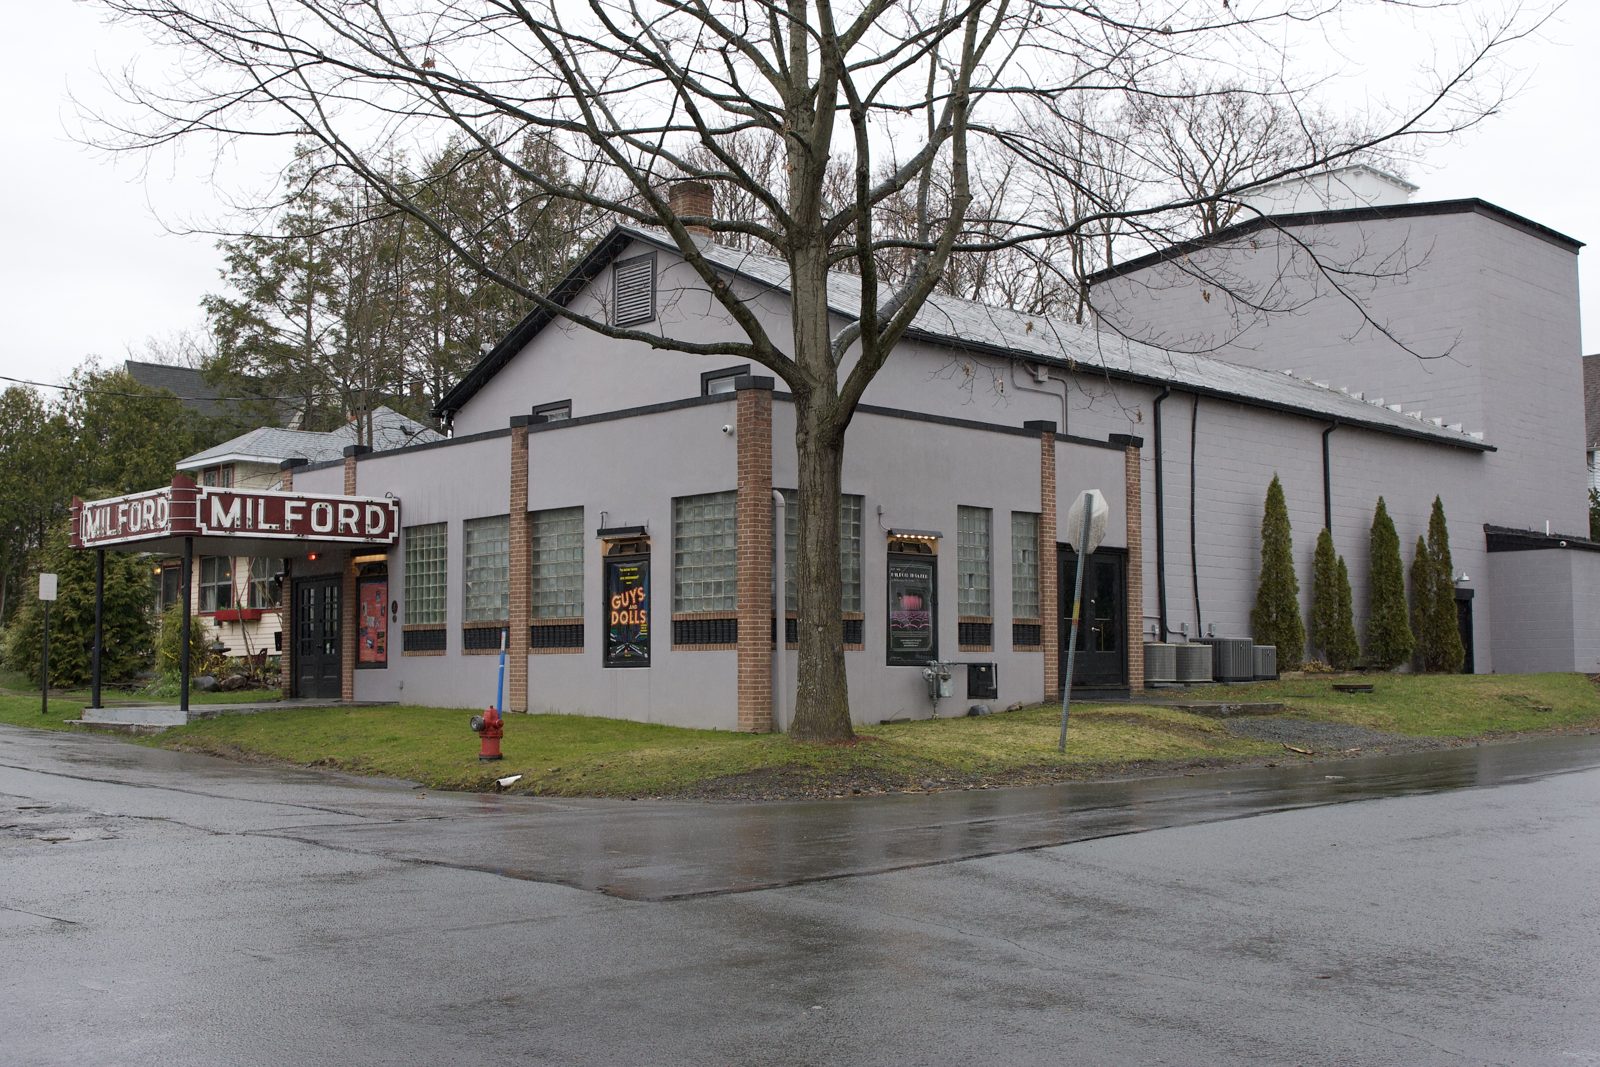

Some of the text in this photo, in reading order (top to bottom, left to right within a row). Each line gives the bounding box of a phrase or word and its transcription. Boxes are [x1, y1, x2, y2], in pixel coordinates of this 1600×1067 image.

[85, 496, 168, 540] MILFORD
[210, 495, 386, 535] MILFORD
[612, 587, 645, 608] GUYS
[611, 609, 646, 624] DOLLS
